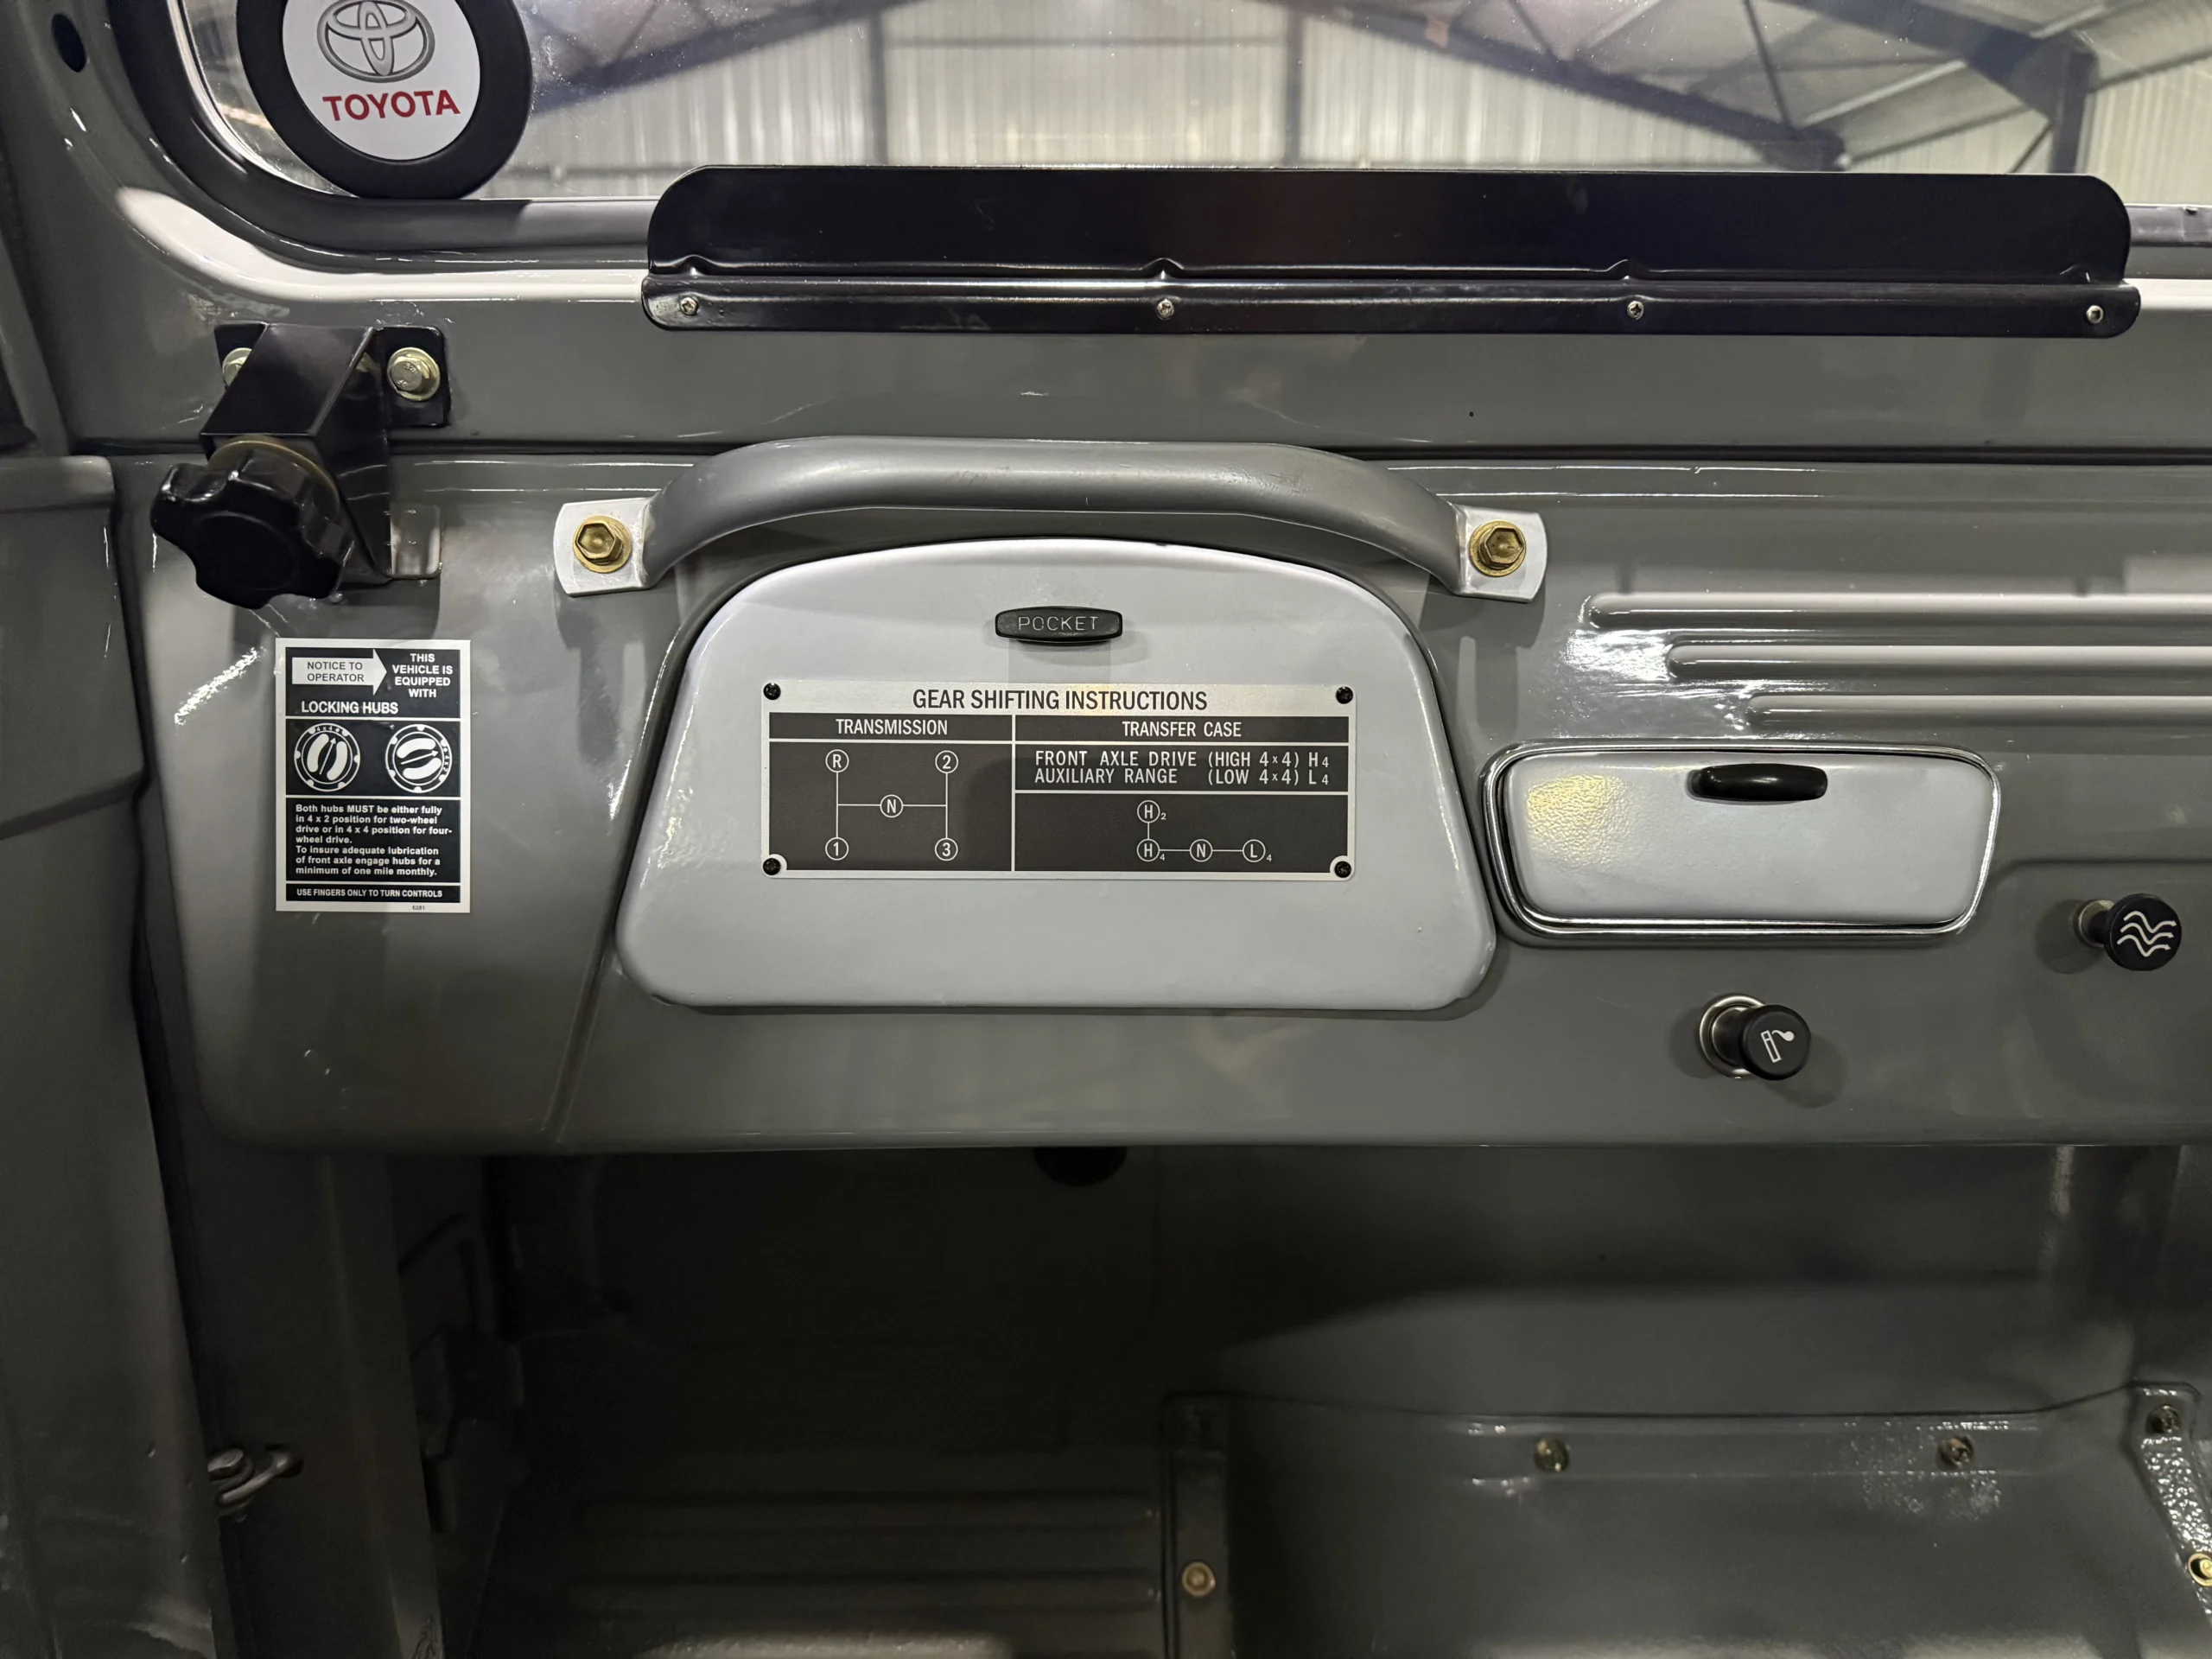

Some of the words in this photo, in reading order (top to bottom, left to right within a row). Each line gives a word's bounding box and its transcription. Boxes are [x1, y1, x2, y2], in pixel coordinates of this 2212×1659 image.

[322, 89, 461, 121] TOYOTA
[1018, 615, 1098, 631] POCKET
[410, 653, 435, 663] THIS
[307, 661, 346, 671] NOTICE
[349, 661, 363, 671] TO
[392, 664, 440, 674] VEHICLE
[442, 665, 453, 675] IS
[307, 673, 365, 683] OPERATOR
[394, 677, 451, 687] EQUIPPED
[409, 689, 436, 698] WITH
[912, 689, 965, 709] GEAR
[970, 690, 1059, 709] SHIFTING
[1065, 690, 1208, 711] INSTRUCTIONS
[302, 701, 359, 714] LOCKING
[362, 701, 398, 715] HUBS
[836, 718, 949, 735] TRANSMISSION
[1122, 721, 1197, 737] TRANSFER
[1203, 721, 1243, 738] CASE
[832, 753, 842, 768] R
[942, 754, 952, 770] 2
[1035, 750, 1088, 766] FRONT
[1099, 750, 1139, 767] AXLE
[1147, 751, 1198, 767] DRIVE
[1207, 751, 1251, 768] (HIGH
[1034, 767, 1115, 785] AUXILIARY
[1124, 768, 1178, 785] RANGE
[1207, 768, 1249, 786] (LOW
[296, 804, 318, 813] Both
[321, 804, 344, 813] hubs
[346, 804, 375, 813] MUST
[377, 805, 389, 814] be
[391, 805, 418, 814] either
[421, 806, 442, 816] fully
[886, 798, 897, 813] N
[323, 815, 330, 823] 2
[332, 815, 371, 825] position
[389, 816, 438, 824] two-wheel
[334, 825, 344, 834] in
[346, 825, 353, 834] 4
[372, 826, 410, 836] position
[412, 826, 427, 835] for
[296, 835, 323, 843] wheel
[325, 836, 353, 844] drive.
[296, 845, 308, 854] To
[341, 846, 386, 856] adequate
[388, 846, 439, 855] lubrication
[832, 842, 840, 856] 1
[941, 842, 952, 857] 3
[1196, 843, 1206, 858] N
[296, 855, 306, 864] of
[333, 856, 353, 865] axle
[392, 857, 416, 866] hubs
[418, 857, 432, 866] for
[373, 867, 394, 875] mile
[397, 868, 437, 877] monthly.
[296, 888, 312, 897] USE
[313, 888, 346, 897] FINGERS
[380, 889, 401, 898] TURN
